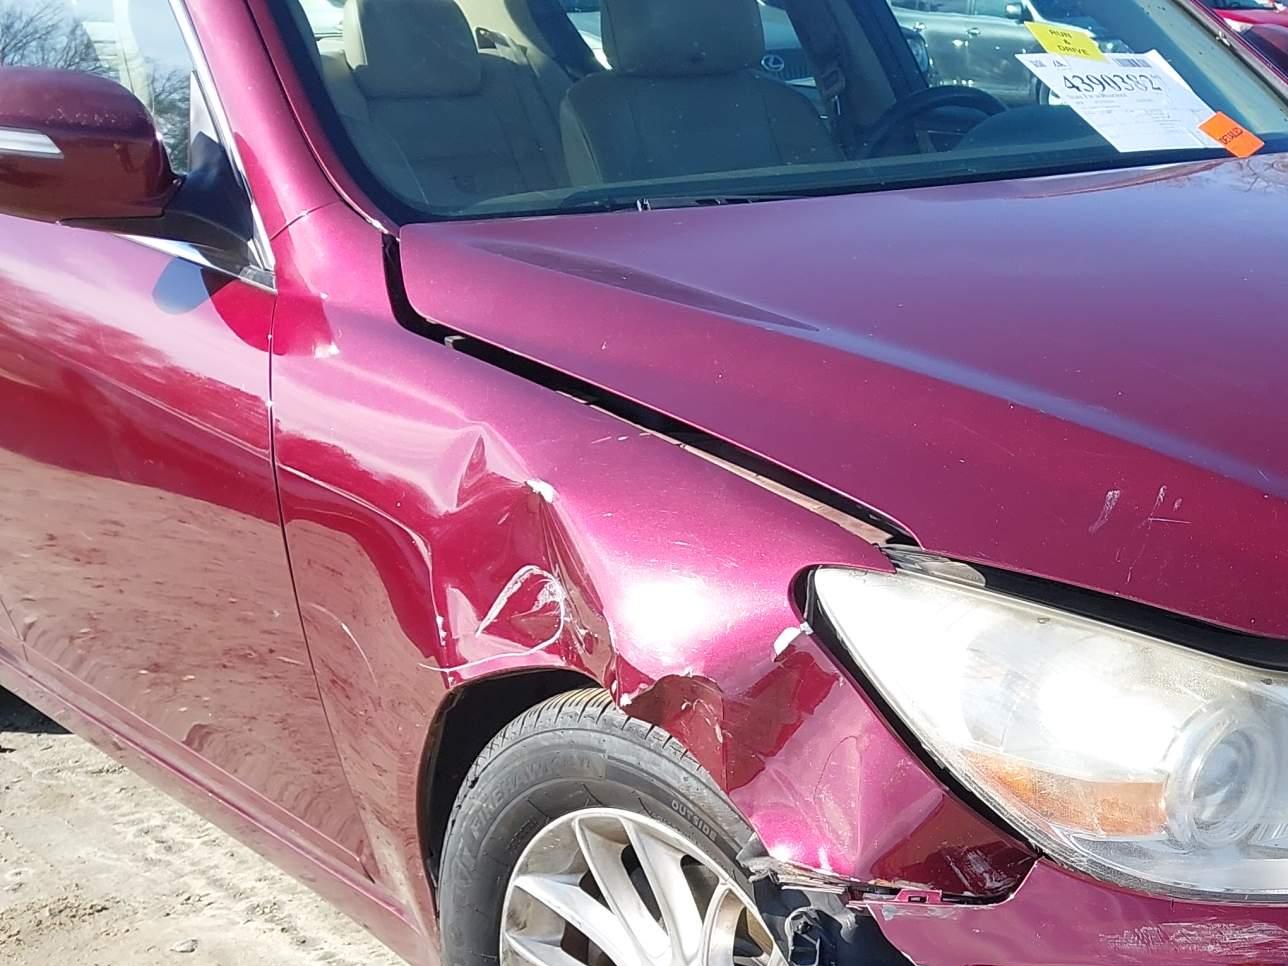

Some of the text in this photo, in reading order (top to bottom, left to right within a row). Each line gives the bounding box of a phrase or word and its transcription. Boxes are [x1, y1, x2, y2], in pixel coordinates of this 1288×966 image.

[1048, 29, 1072, 39] RUN
[1057, 44, 1090, 56] DRIVE
[671, 799, 718, 841] OUTSIDE
